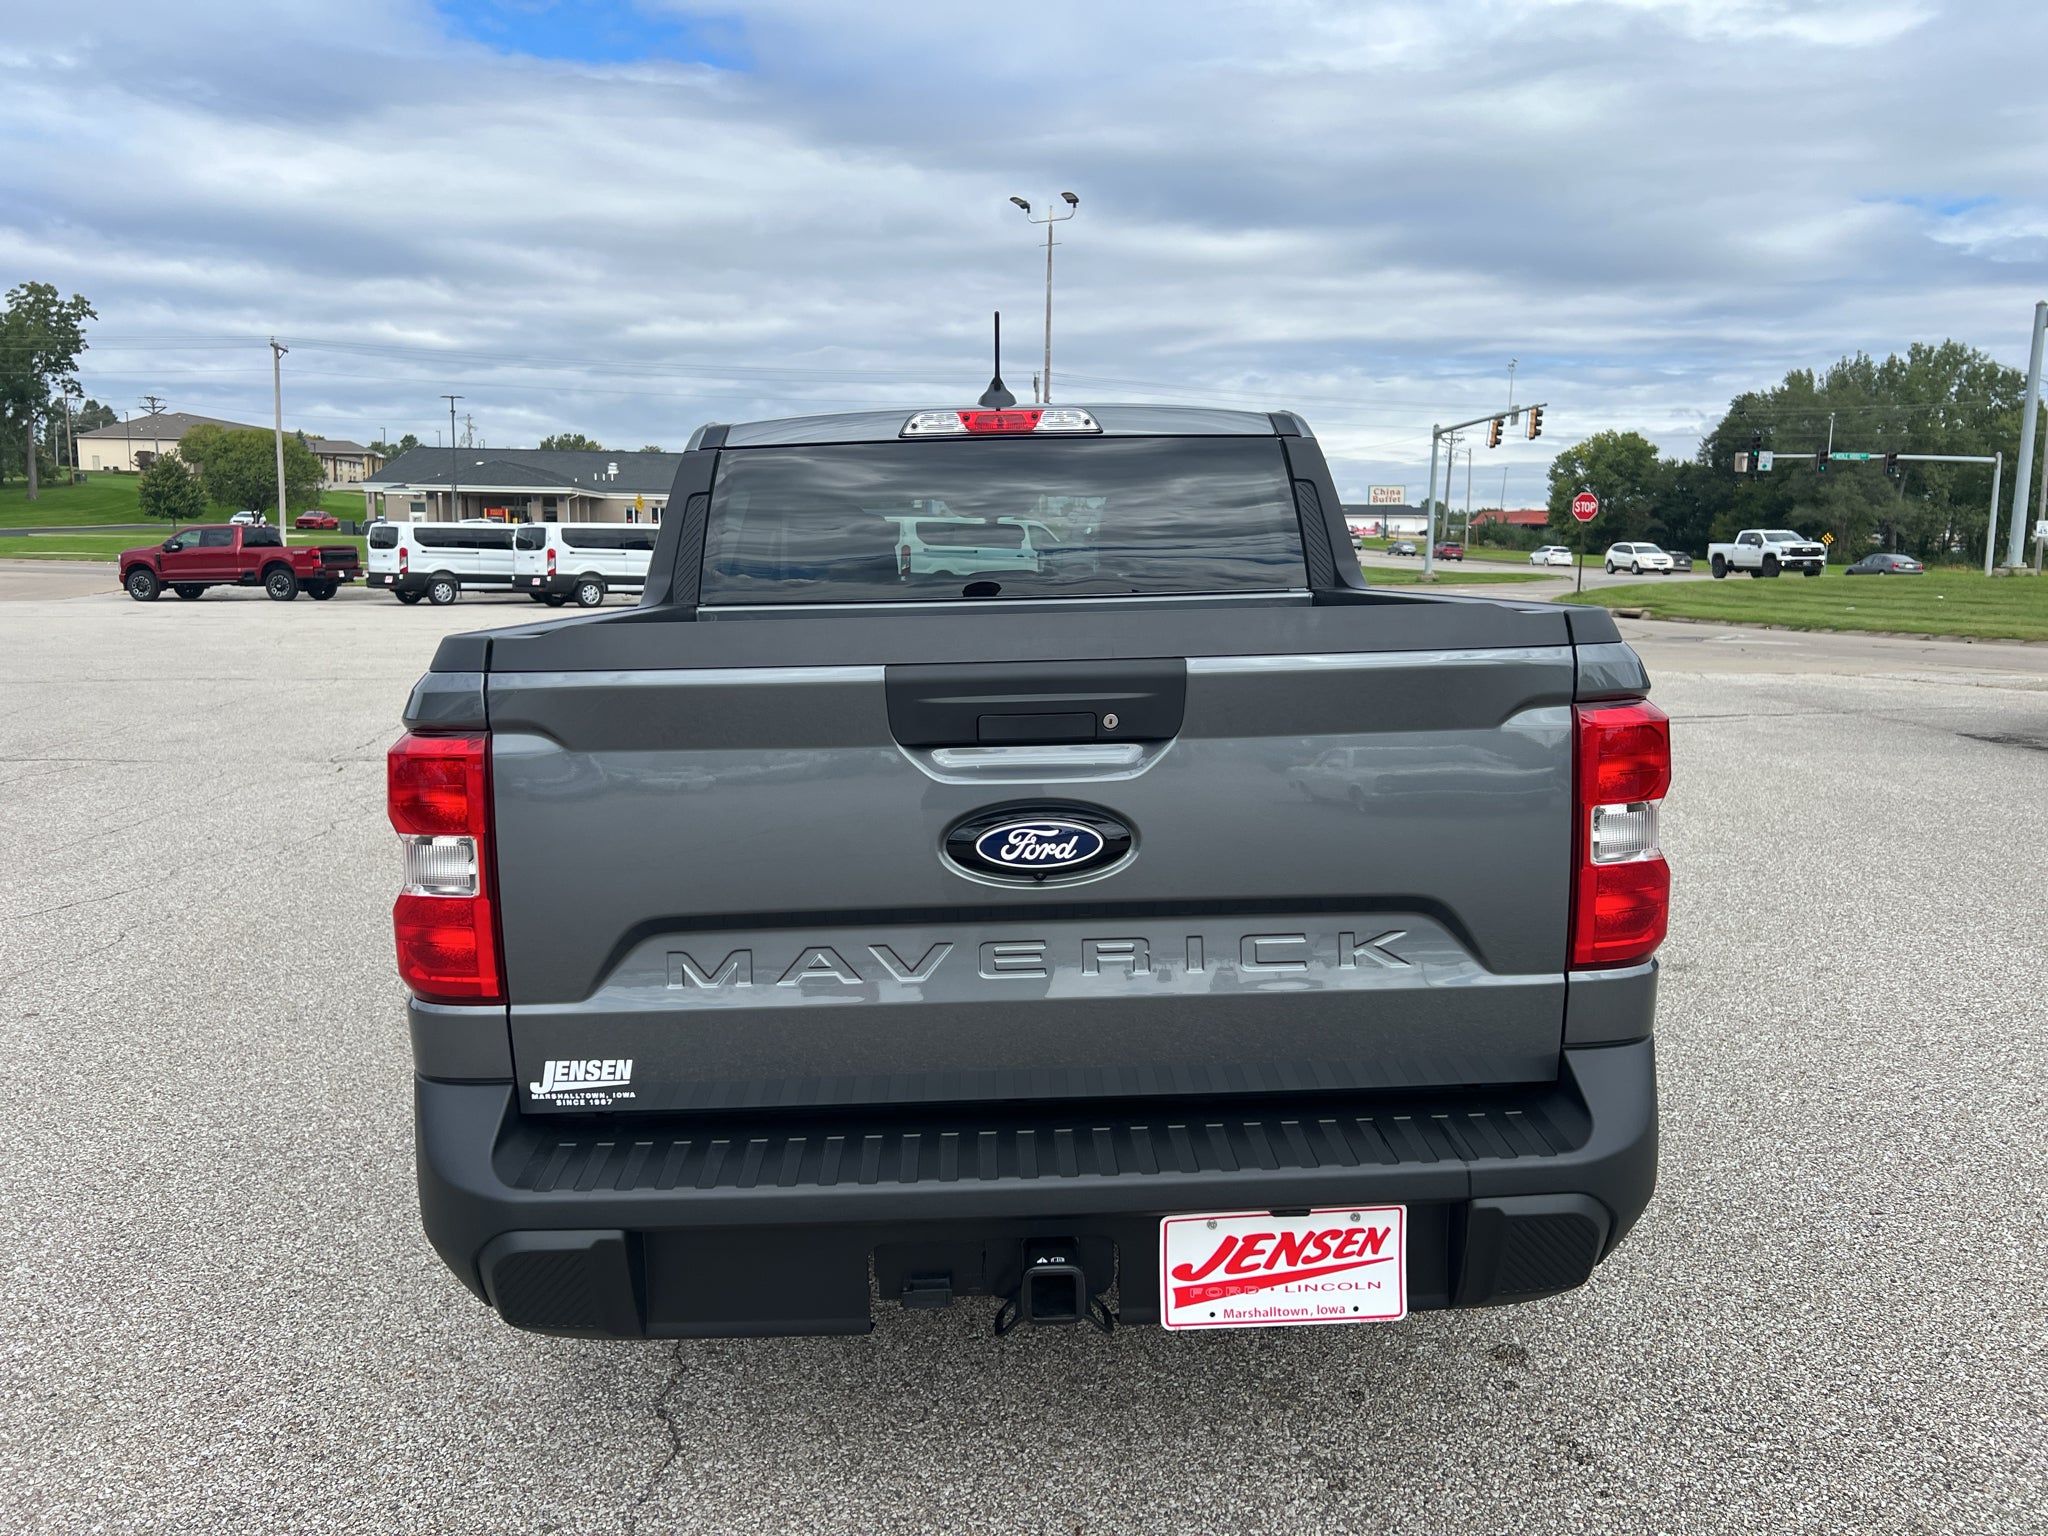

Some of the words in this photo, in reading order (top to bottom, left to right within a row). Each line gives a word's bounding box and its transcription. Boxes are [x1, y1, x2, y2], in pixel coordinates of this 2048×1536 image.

[1373, 488, 1401, 496] China
[1575, 501, 1596, 513] STOP
[1000, 828, 1079, 861] Ford
[666, 930, 1411, 991] MAVERICK
[529, 1059, 633, 1094] JENSEN
[1171, 1226, 1391, 1282] JENSEN
[1189, 1285, 1260, 1298] FORD
[1285, 1281, 1382, 1293] LINCOLN
[1223, 1307, 1314, 1319] Marshalltown,
[1317, 1305, 1345, 1315] Iowa
